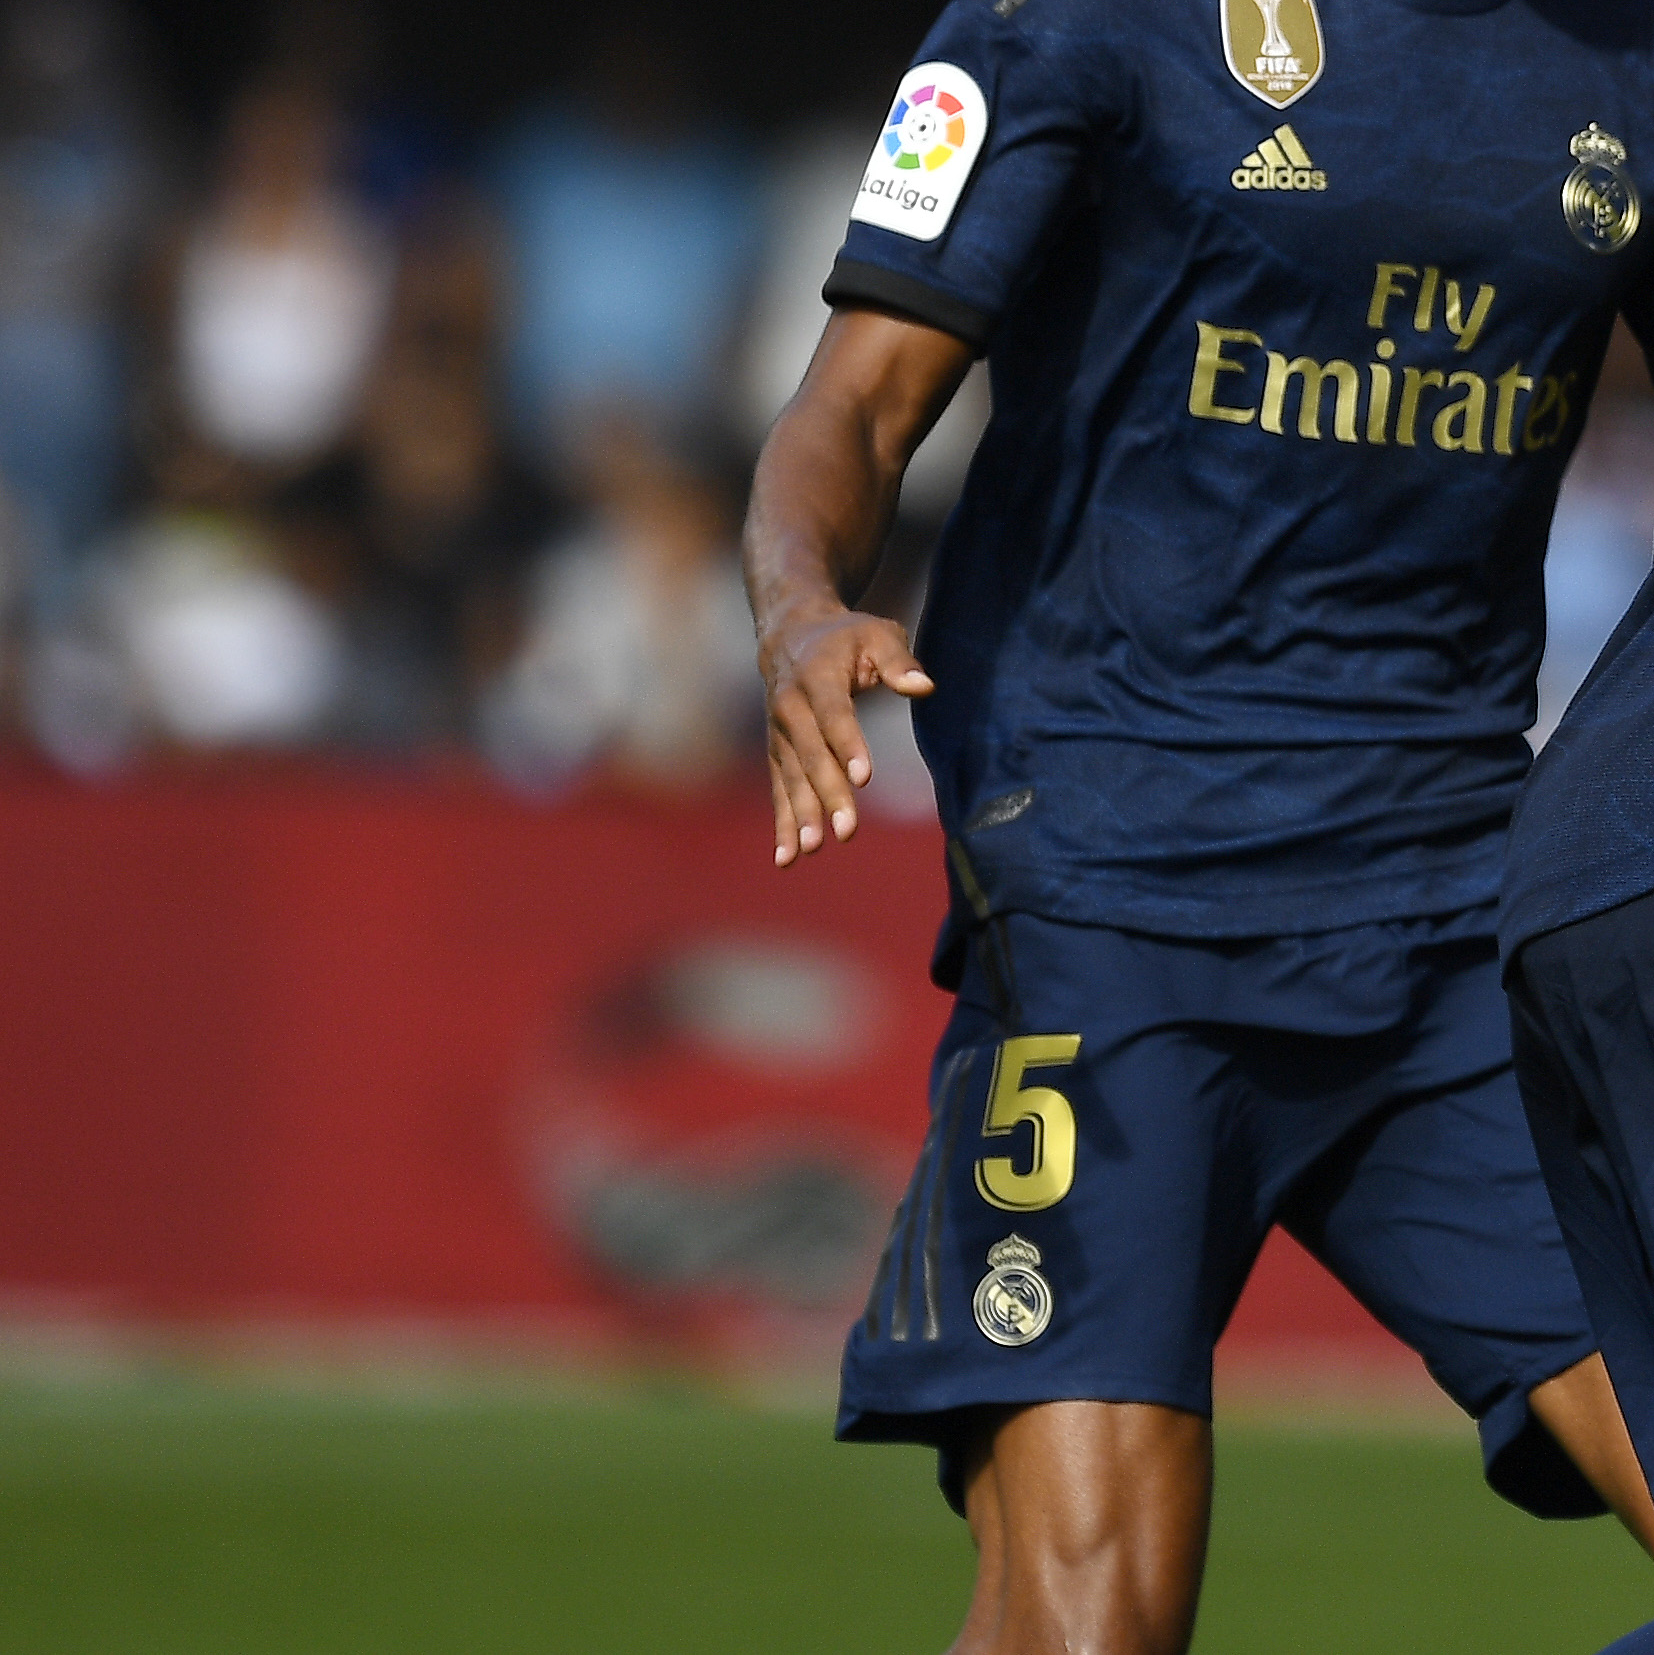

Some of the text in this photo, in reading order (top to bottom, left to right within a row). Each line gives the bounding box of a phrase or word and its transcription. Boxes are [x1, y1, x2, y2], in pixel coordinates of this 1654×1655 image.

[861, 172, 939, 213] LaLiga
[1230, 163, 1329, 192] adidas
[1365, 262, 1496, 352] Fly
[972, 1032, 1083, 1213] 5
